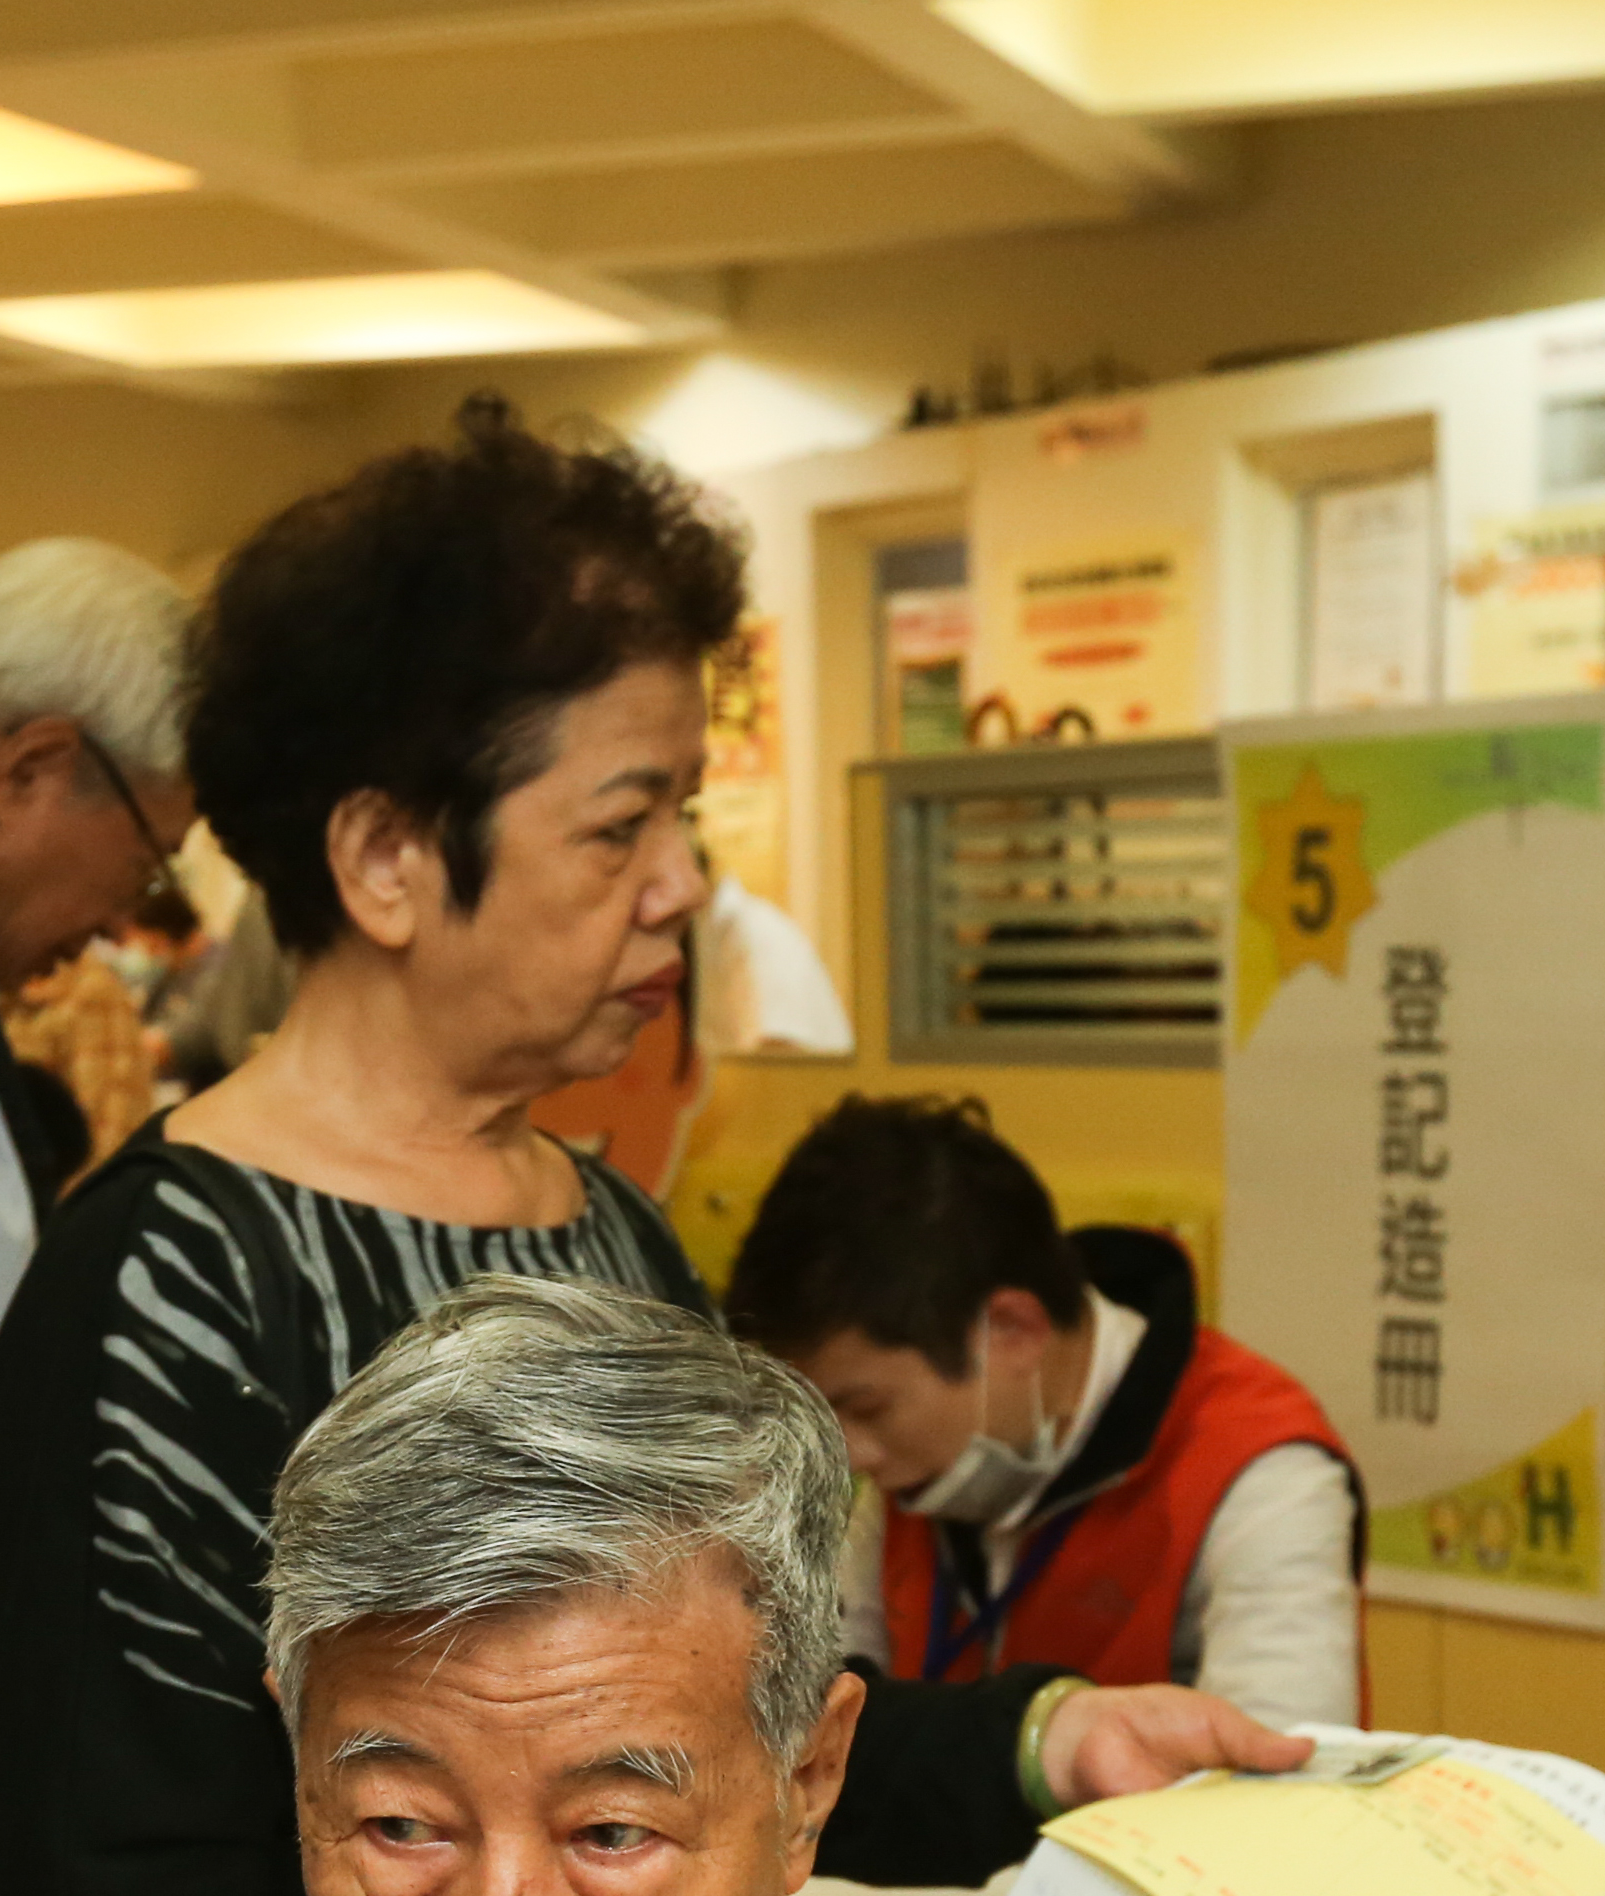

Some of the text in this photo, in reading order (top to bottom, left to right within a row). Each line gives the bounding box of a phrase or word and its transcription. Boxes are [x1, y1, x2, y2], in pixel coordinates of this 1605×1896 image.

[1289, 827, 1336, 933] 5
[1372, 943, 1449, 1426] 登記造冊
